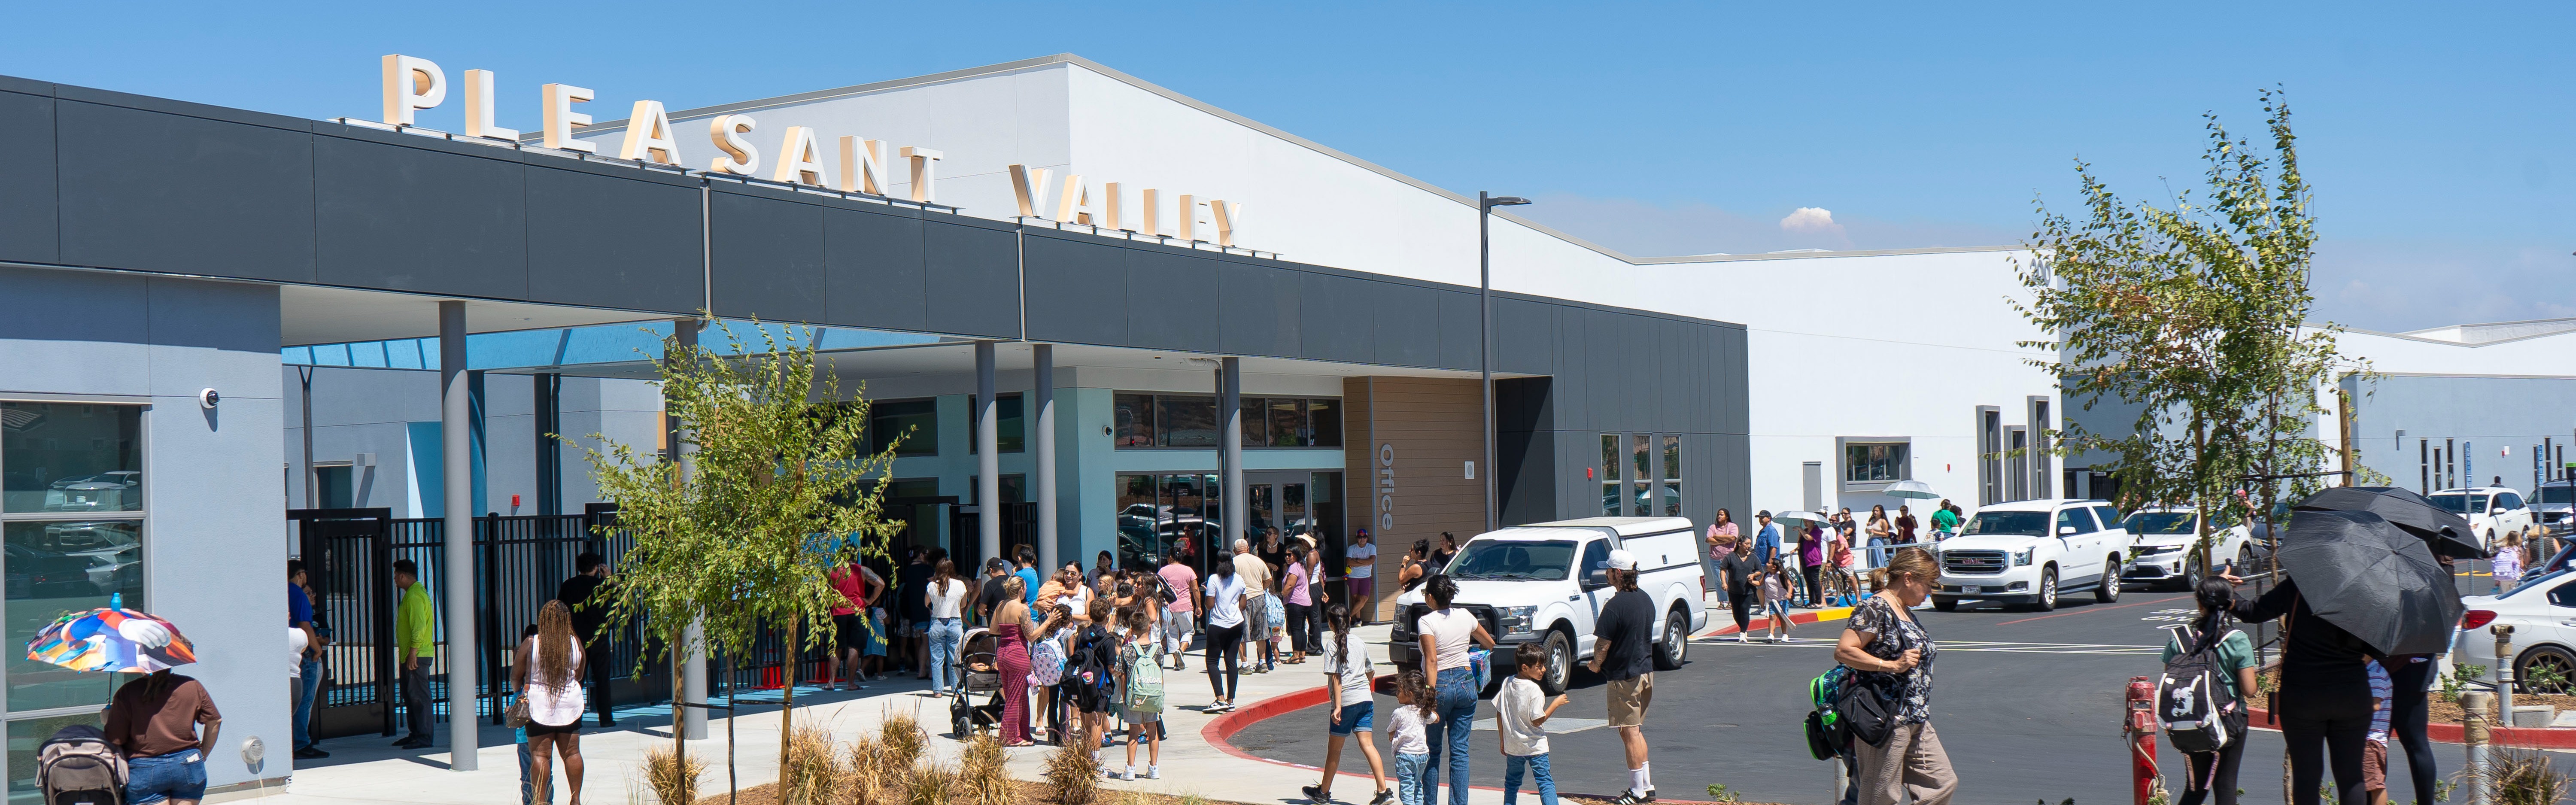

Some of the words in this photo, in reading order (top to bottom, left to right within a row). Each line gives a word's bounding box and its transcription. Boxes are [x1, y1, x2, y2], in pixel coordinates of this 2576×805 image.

[382, 54, 944, 202] PLEASANT
[1008, 164, 1242, 247] VALLEY
[1380, 444, 1394, 531] Office
